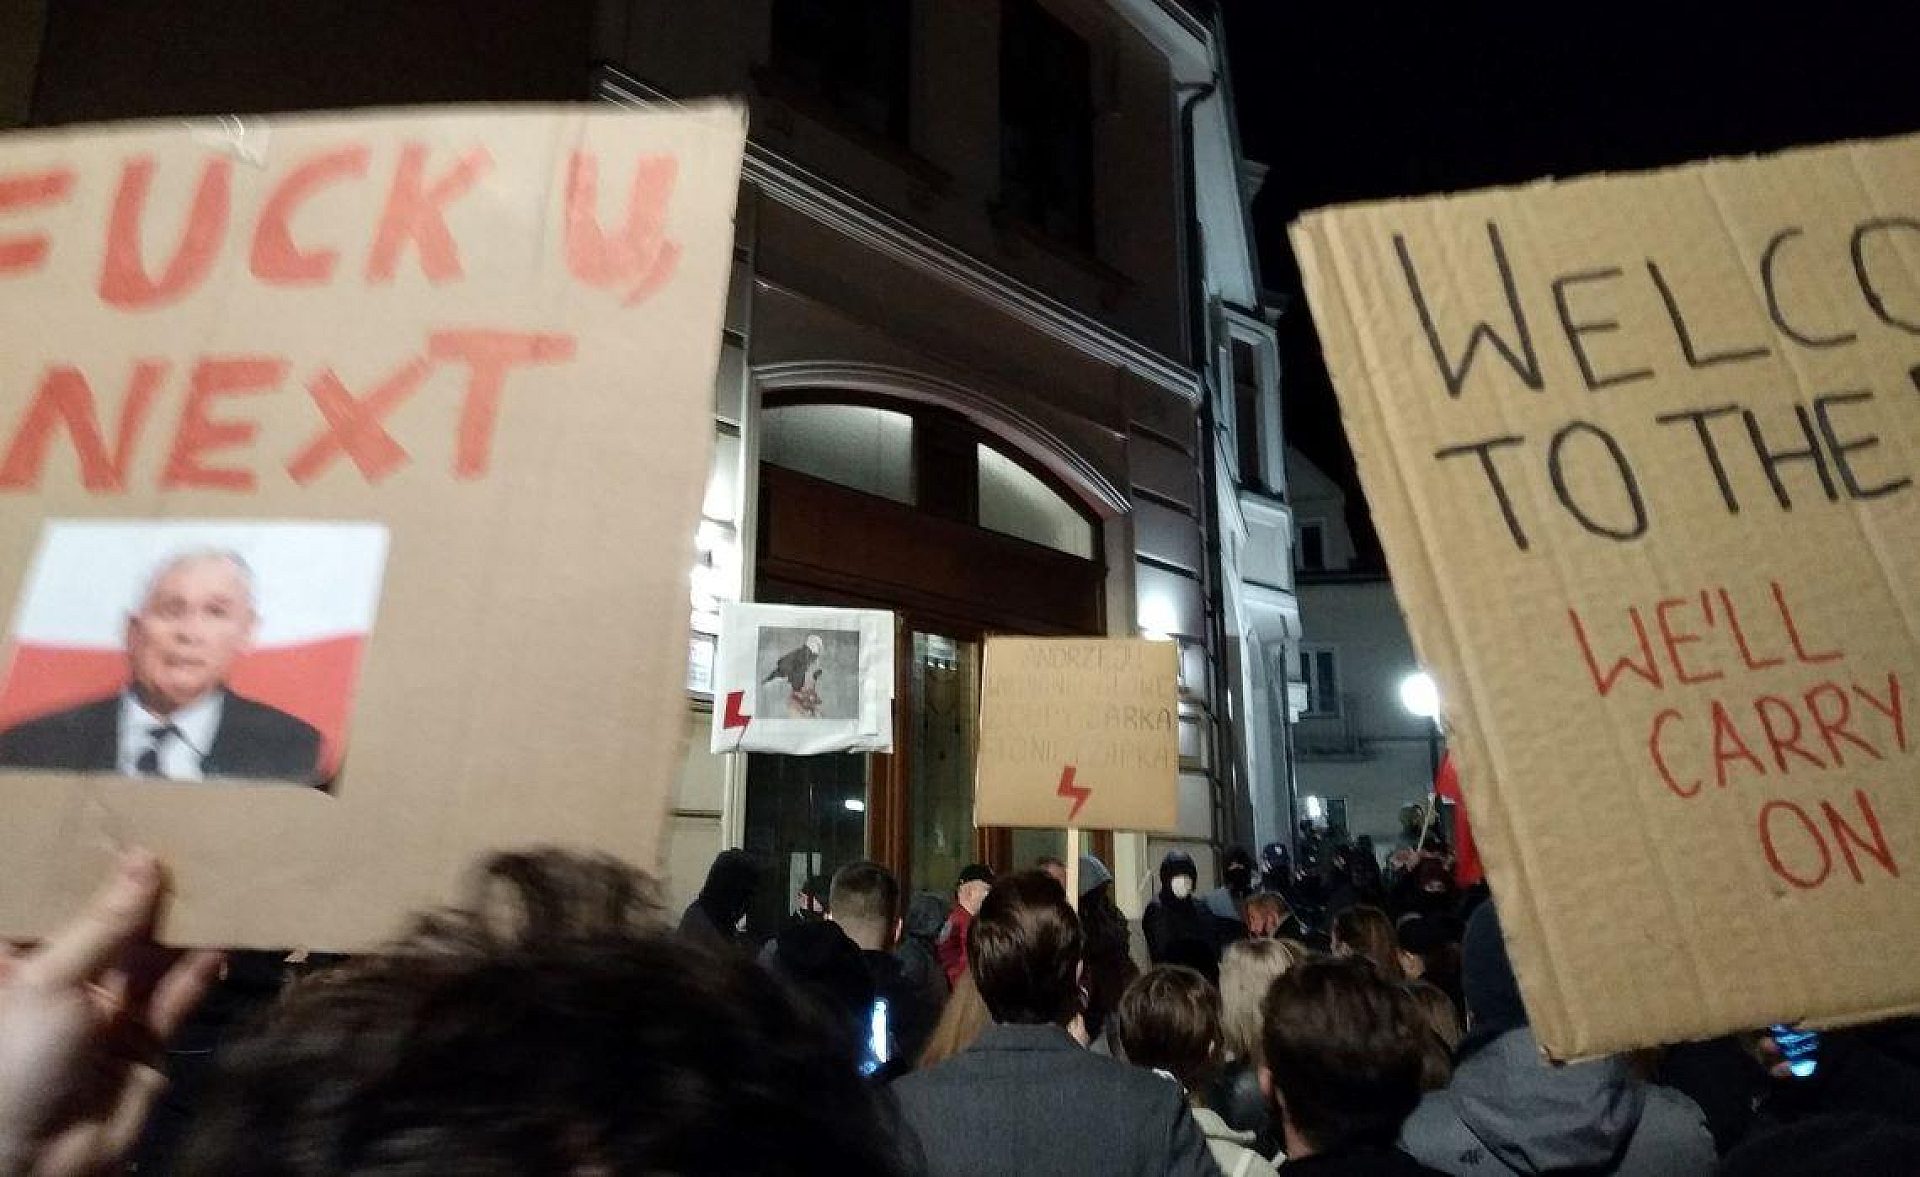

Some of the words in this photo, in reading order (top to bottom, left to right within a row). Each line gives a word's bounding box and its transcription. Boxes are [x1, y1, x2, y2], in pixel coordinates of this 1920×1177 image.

[0, 328, 577, 496] NEXT
[1434, 420, 1648, 551] TO
[1656, 391, 1912, 515] THE
[1567, 581, 1844, 697] WE'LL
[1650, 672, 1906, 798] CARRY
[1758, 789, 1900, 889] ON
